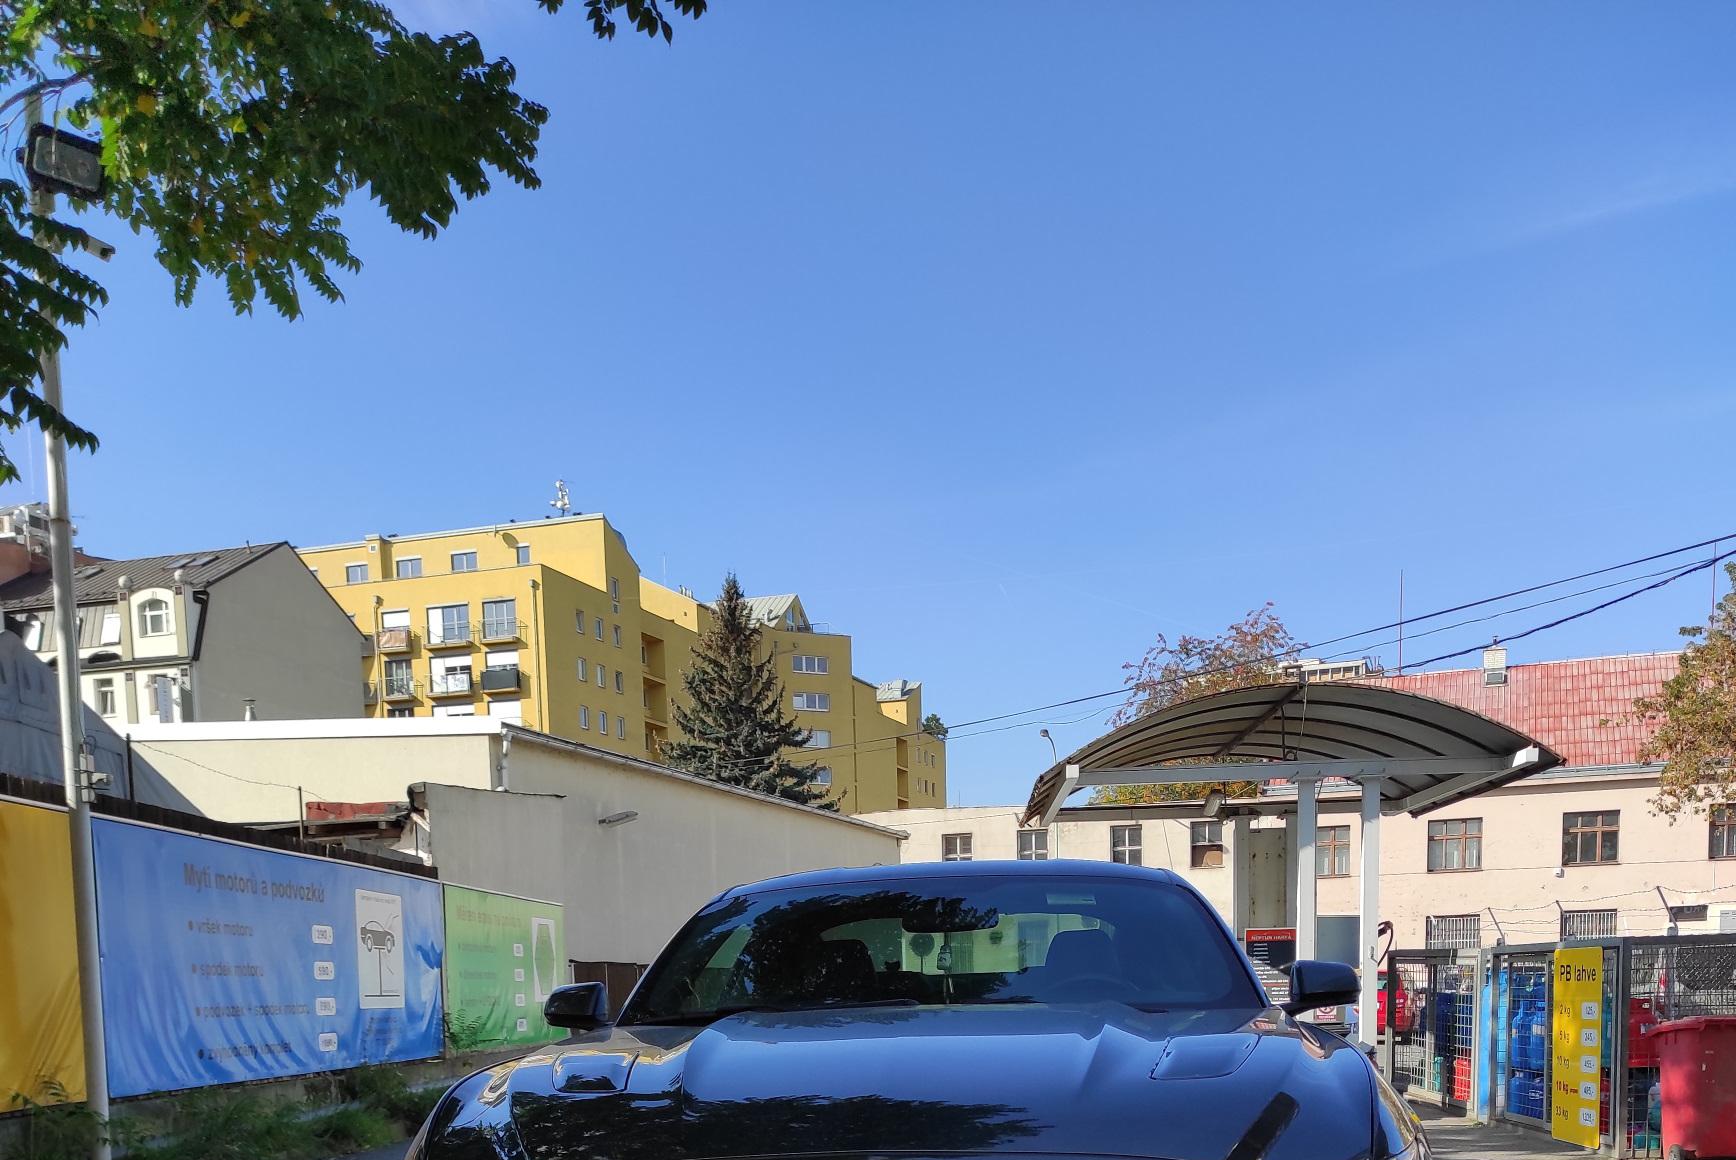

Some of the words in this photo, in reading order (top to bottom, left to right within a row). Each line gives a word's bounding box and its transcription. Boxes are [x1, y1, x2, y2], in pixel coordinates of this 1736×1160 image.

[261, 879, 268, 896] a
[1559, 965, 1572, 981] PB
[1574, 964, 1597, 982] lahve
[1559, 1004, 1564, 1015] 2
[1564, 1006, 1571, 1018] kg
[1559, 1030, 1563, 1041] 5
[1563, 1030, 1570, 1044] kg
[1563, 1057, 1569, 1069] kg
[1556, 1081, 1562, 1092] 10
[1562, 1081, 1569, 1095] kg
[1555, 1106, 1561, 1117] 33
[1562, 1107, 1569, 1120] kg
